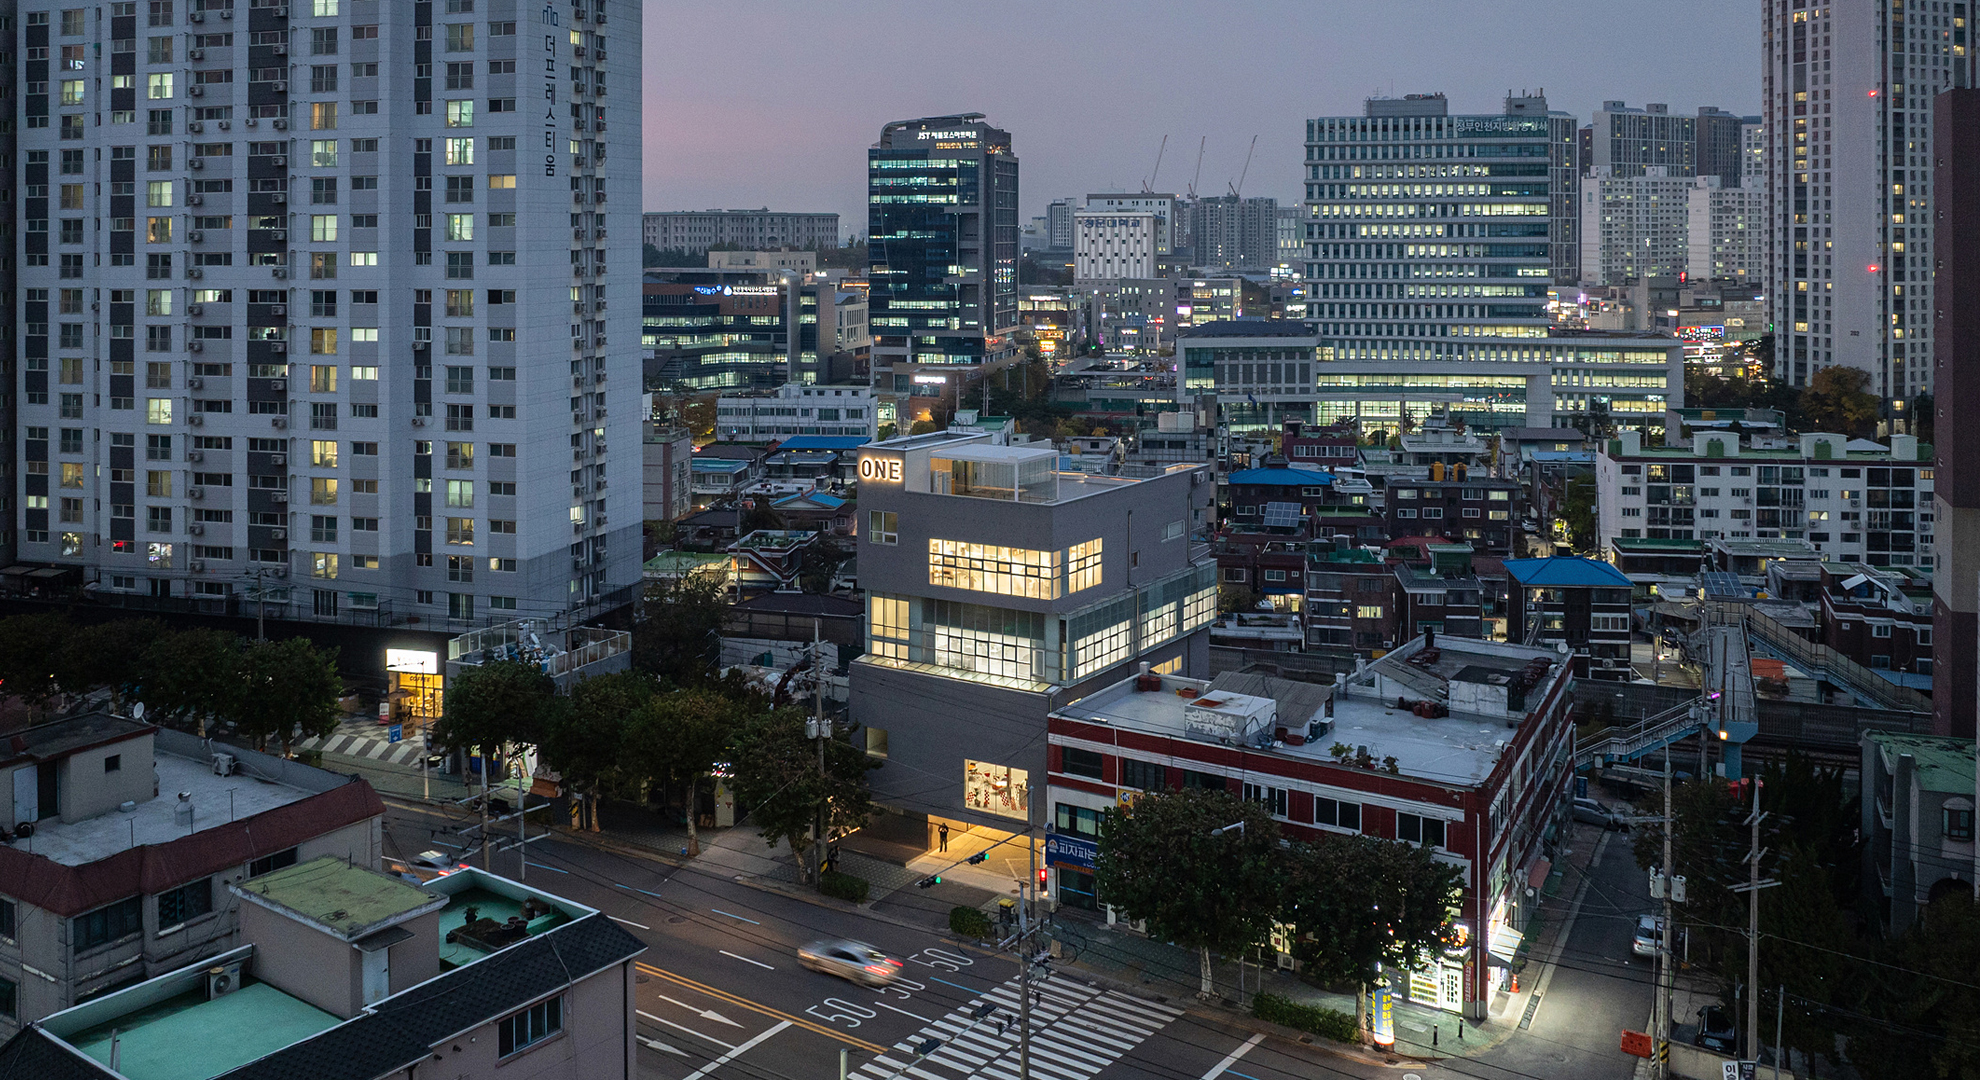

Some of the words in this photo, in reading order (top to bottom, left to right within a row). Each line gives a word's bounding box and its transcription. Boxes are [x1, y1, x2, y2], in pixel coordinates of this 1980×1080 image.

[545, 35, 555, 177] 더프레스티움
[917, 131, 931, 140] JST
[861, 459, 900, 480] ONE
[907, 948, 974, 973] 50
[805, 997, 877, 1028] 50
